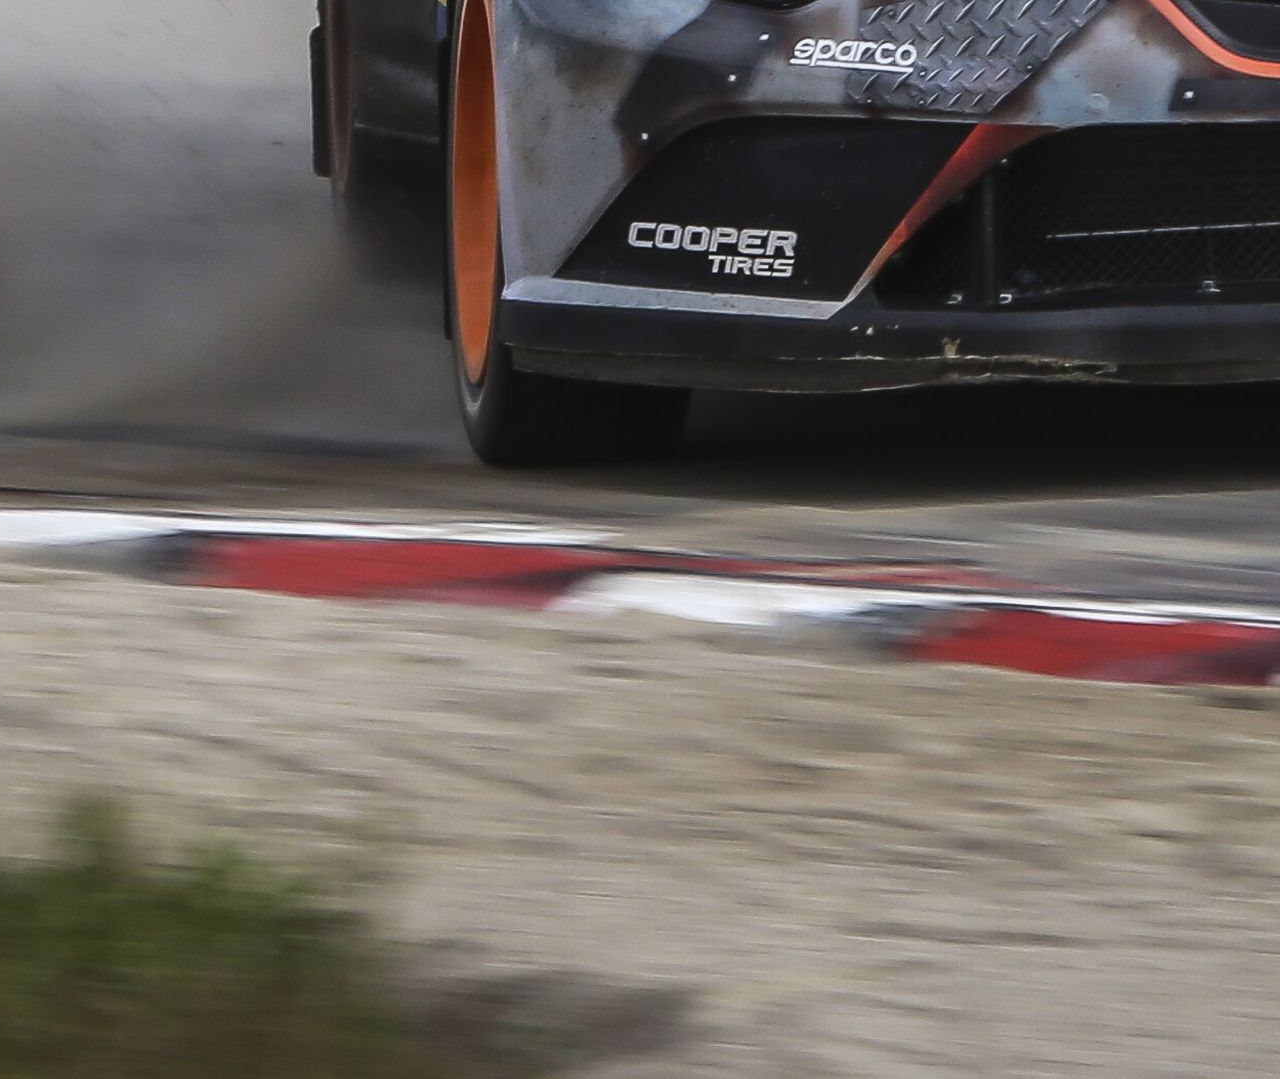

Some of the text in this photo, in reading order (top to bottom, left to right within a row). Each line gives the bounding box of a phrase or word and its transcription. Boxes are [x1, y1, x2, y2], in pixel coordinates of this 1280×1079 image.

[793, 36, 918, 67] sparco
[627, 221, 798, 256] COOPER
[707, 254, 795, 279] TIRES
